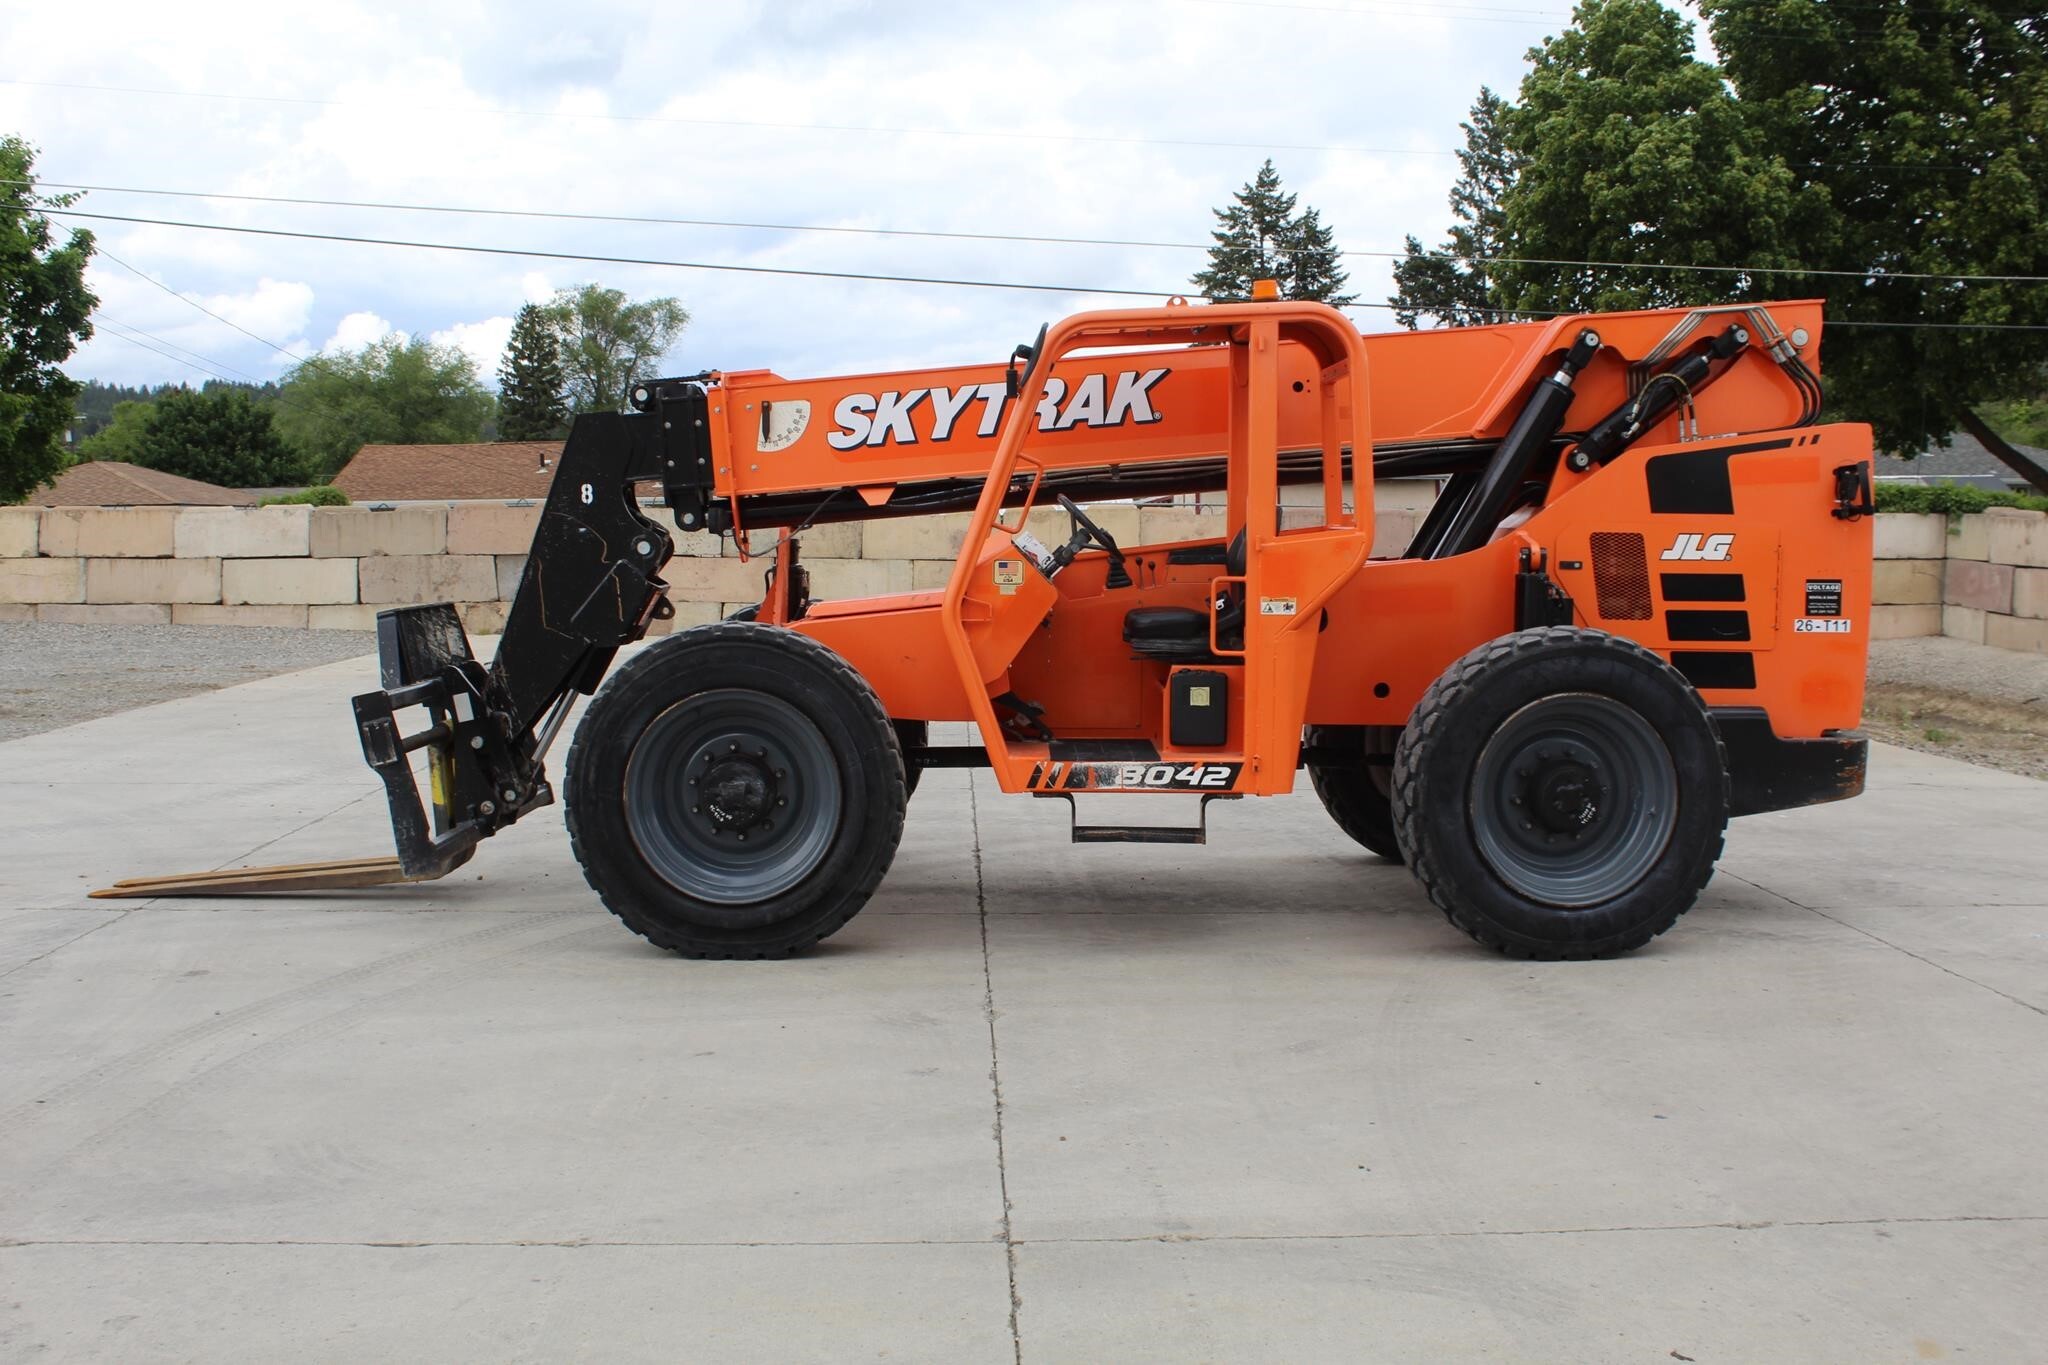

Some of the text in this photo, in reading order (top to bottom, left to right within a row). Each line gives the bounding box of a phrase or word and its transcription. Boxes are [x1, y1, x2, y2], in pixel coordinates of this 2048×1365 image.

[827, 368, 1171, 450] SKYTRAK
[581, 483, 593, 504] 8
[1659, 533, 1736, 561] JLG
[1796, 619, 1848, 631] 26-T11
[1115, 765, 1231, 786] 8042
